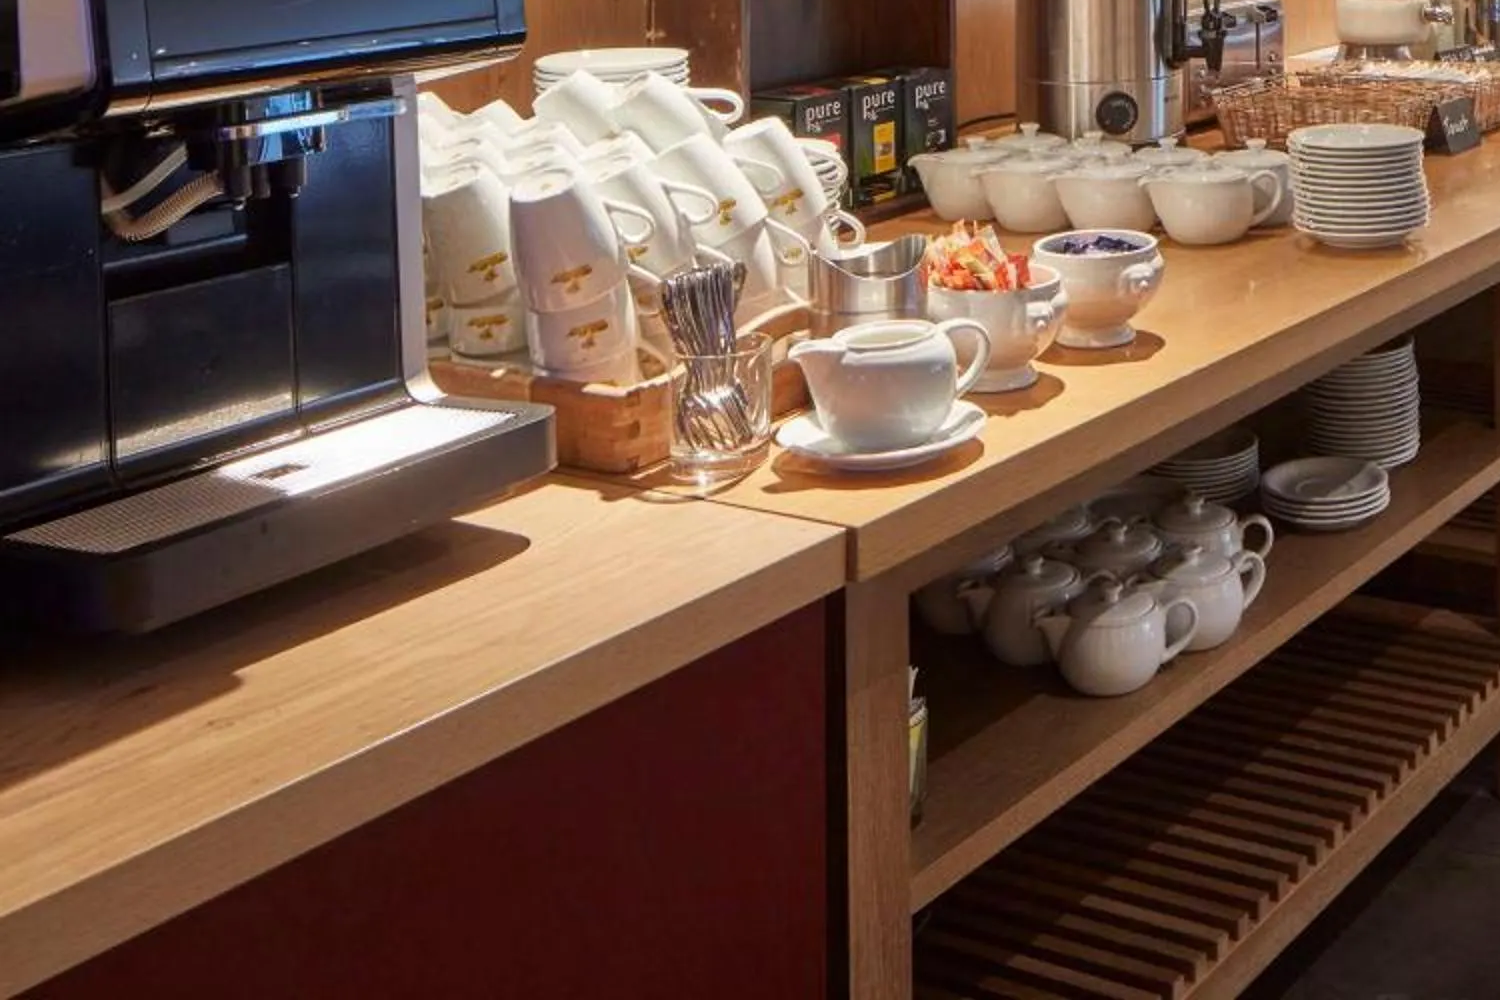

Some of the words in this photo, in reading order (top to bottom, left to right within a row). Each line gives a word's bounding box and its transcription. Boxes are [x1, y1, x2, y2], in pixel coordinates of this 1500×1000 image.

[863, 89, 896, 118] pure
[915, 80, 946, 107] pure
[805, 101, 842, 130] pure
